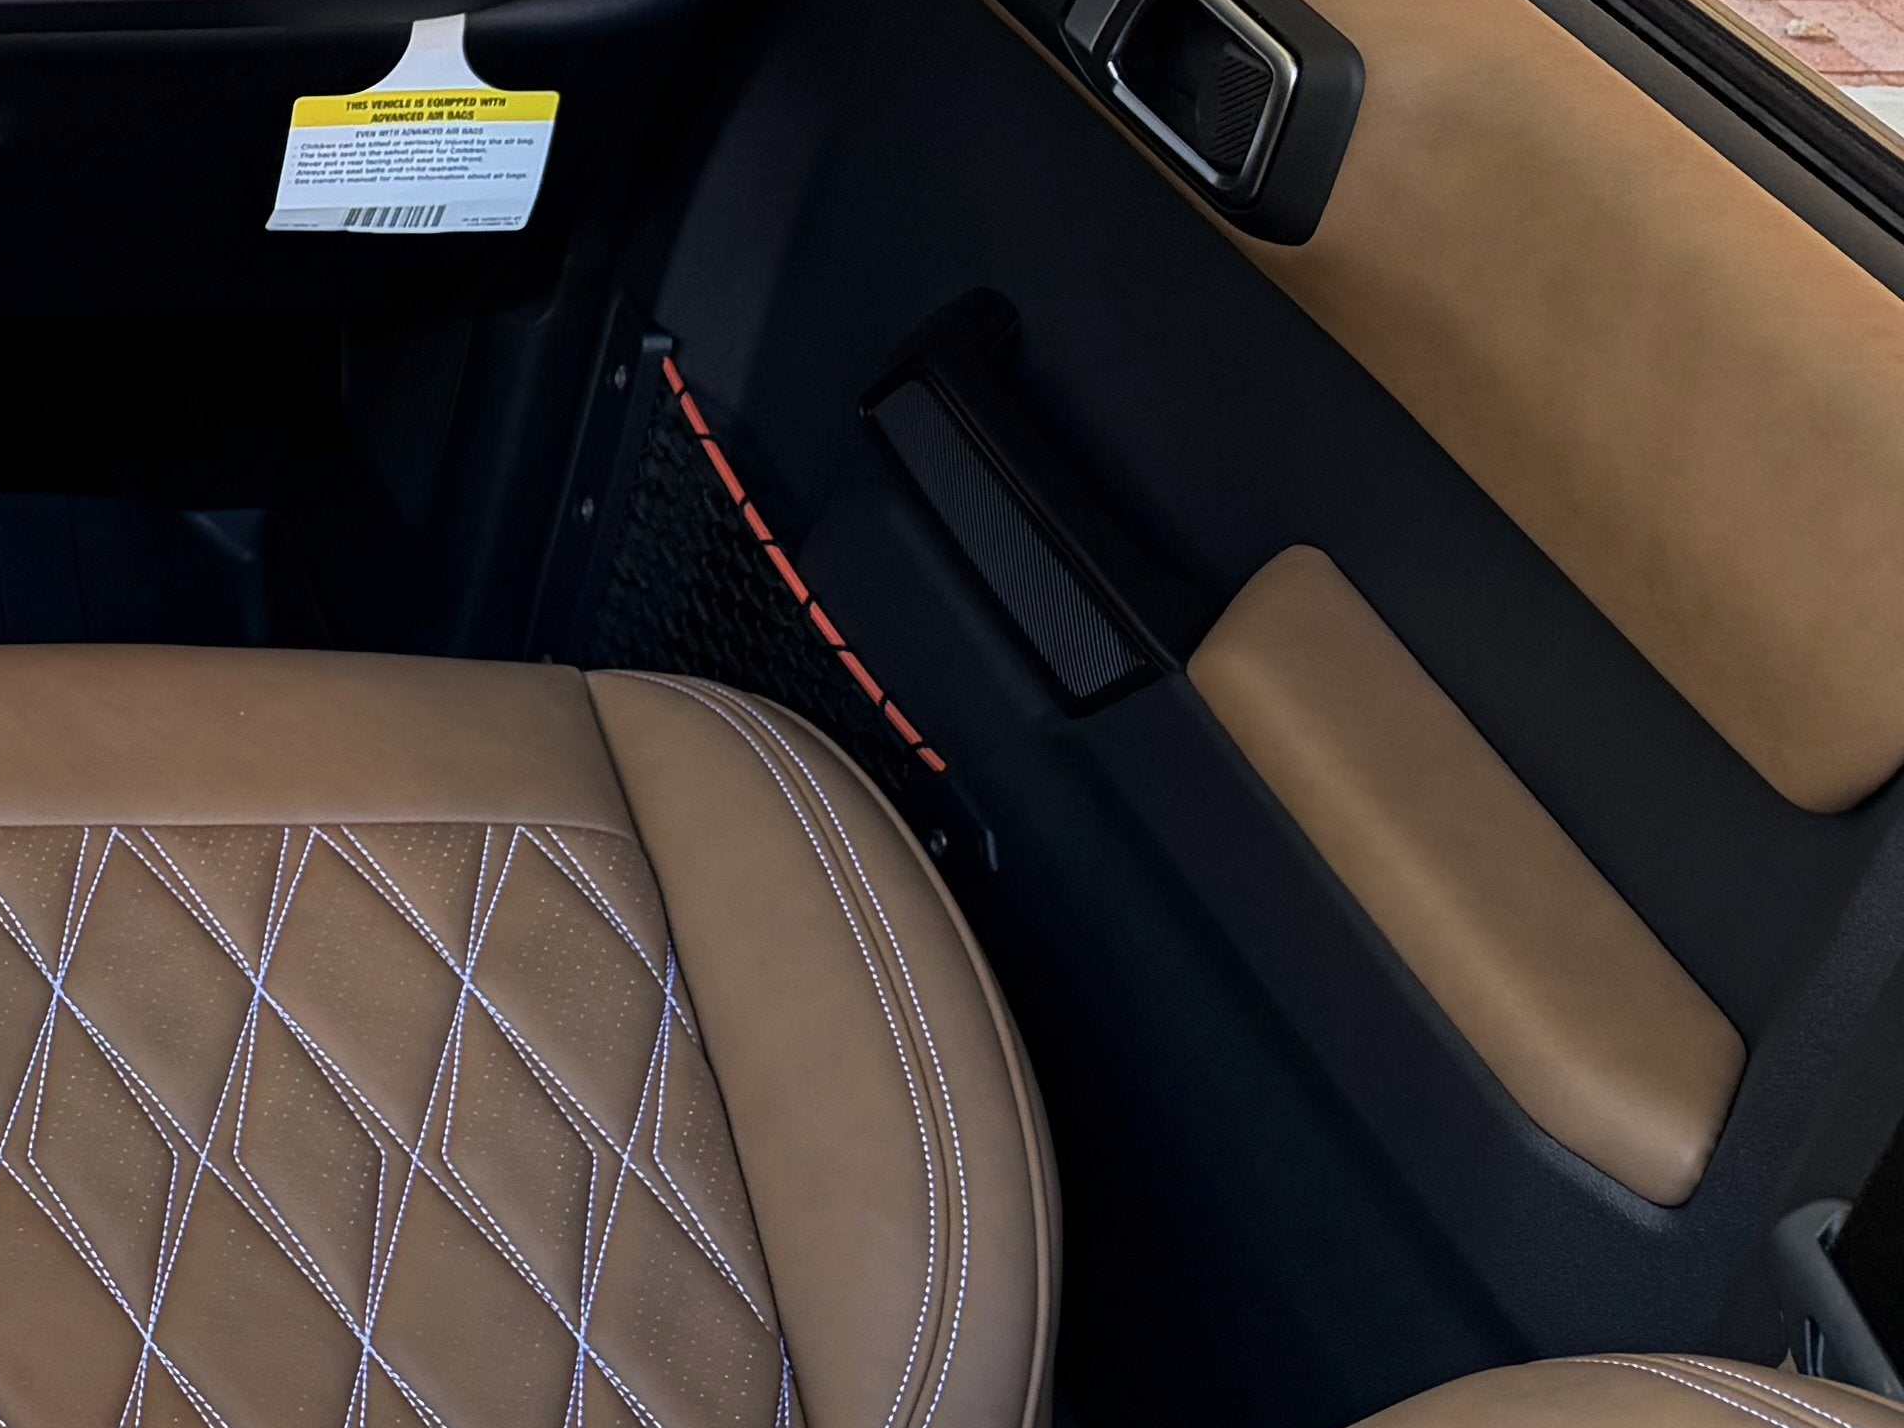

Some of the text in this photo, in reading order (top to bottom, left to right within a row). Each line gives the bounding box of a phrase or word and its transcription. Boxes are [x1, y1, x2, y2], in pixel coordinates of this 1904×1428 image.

[346, 97, 507, 111] THIS VEHICLE IS EQUIPPED WITH
[370, 110, 475, 123] ADVANCED AIR BAGS
